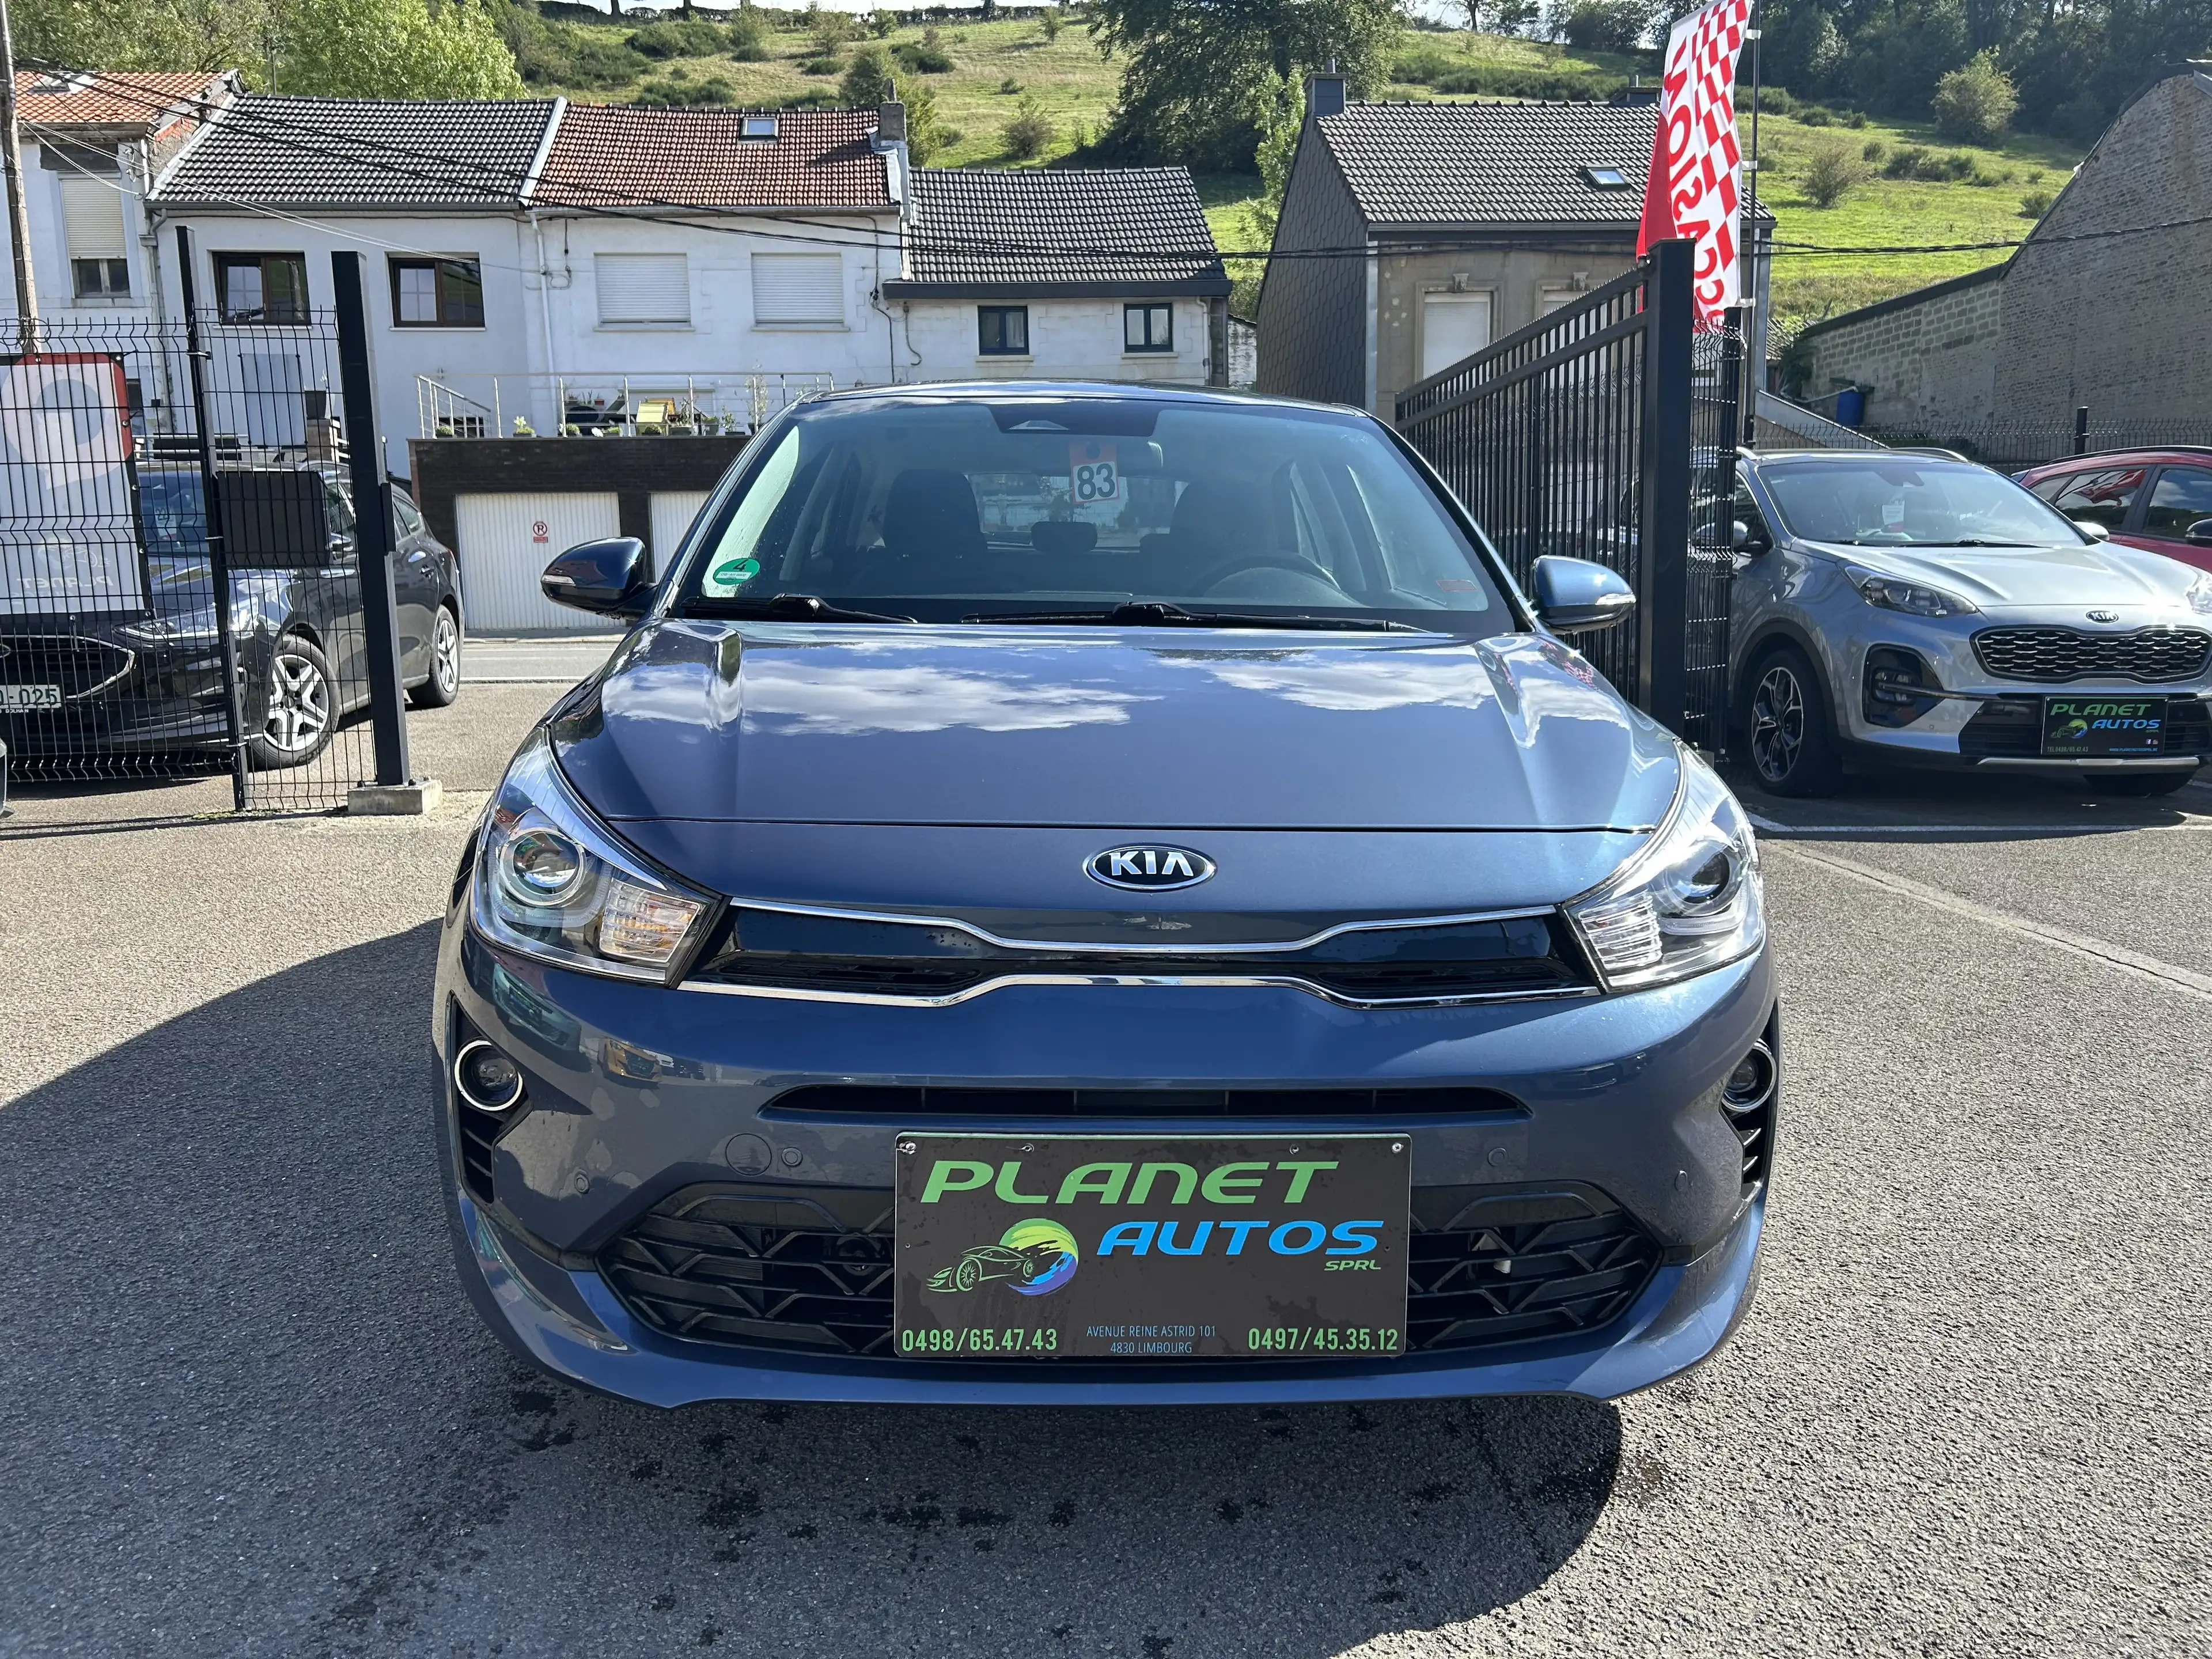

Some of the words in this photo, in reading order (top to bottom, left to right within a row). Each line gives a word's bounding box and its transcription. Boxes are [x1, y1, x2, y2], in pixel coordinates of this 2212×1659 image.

[1077, 463, 1115, 500] 83
[733, 559, 749, 571] 4
[2090, 612, 2115, 620] KIA
[2050, 704, 2152, 716] PLANET
[2092, 719, 2161, 729] AUTOS
[1109, 850, 1194, 877] KIA
[921, 1160, 1339, 1205] PLANET
[1096, 1220, 1384, 1256] AUTOS
[1324, 1259, 1382, 1271] SPRL
[1086, 1325, 1126, 1337] AVENUE
[1129, 1325, 1158, 1337] REINE
[1161, 1325, 1195, 1337] ASTRID
[1199, 1325, 1215, 1337] 101
[902, 1328, 1058, 1351] 0498/65.47.43
[1248, 1327, 1399, 1351] 0497/45.35.12
[1110, 1342, 1135, 1353] 4830
[1138, 1342, 1192, 1353] LIMBOURG
